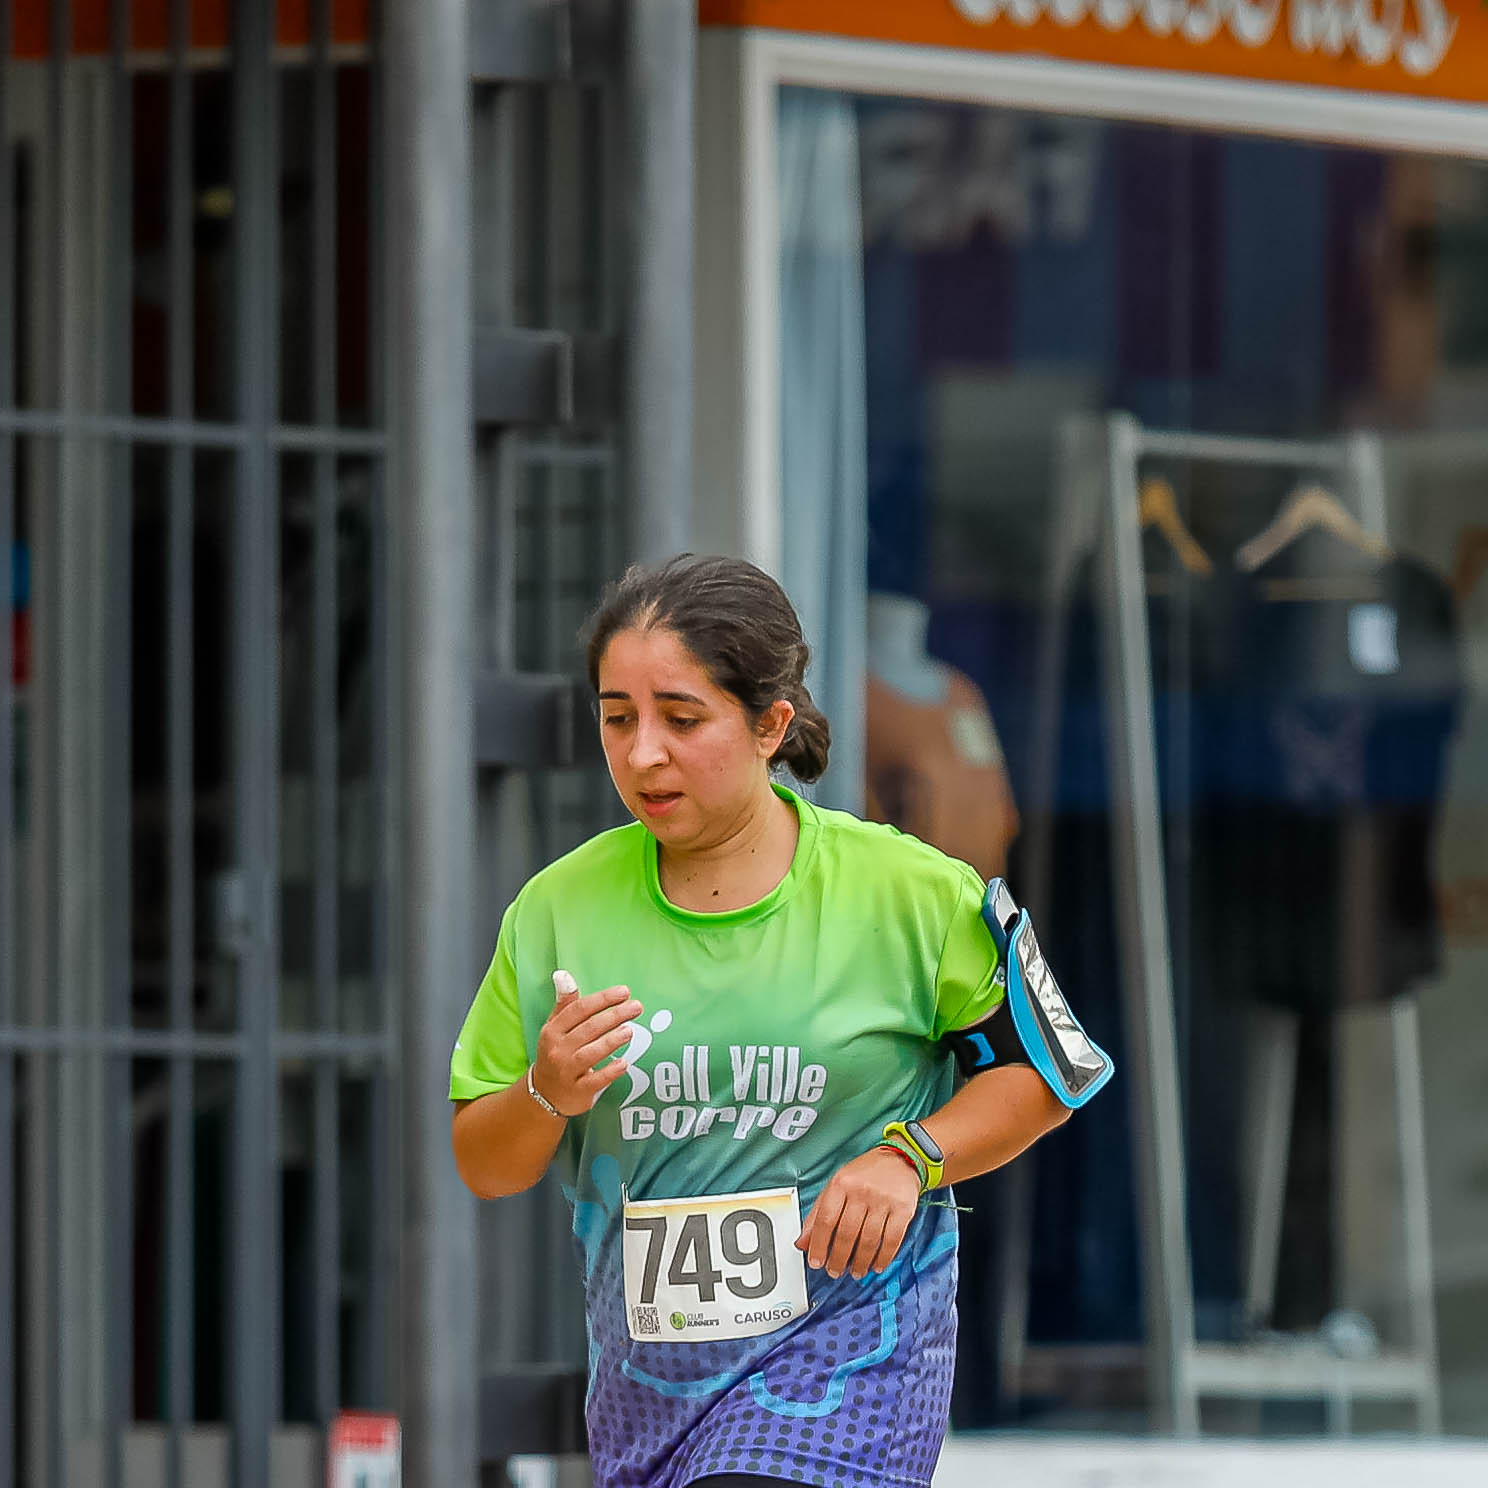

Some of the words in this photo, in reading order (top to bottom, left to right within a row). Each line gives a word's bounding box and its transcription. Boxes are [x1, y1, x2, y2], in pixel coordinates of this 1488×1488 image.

[729, 1045, 827, 1103] Ville
[619, 1105, 818, 1141] corre
[626, 1209, 778, 1304] 749
[734, 1309, 792, 1324] CARUSO
